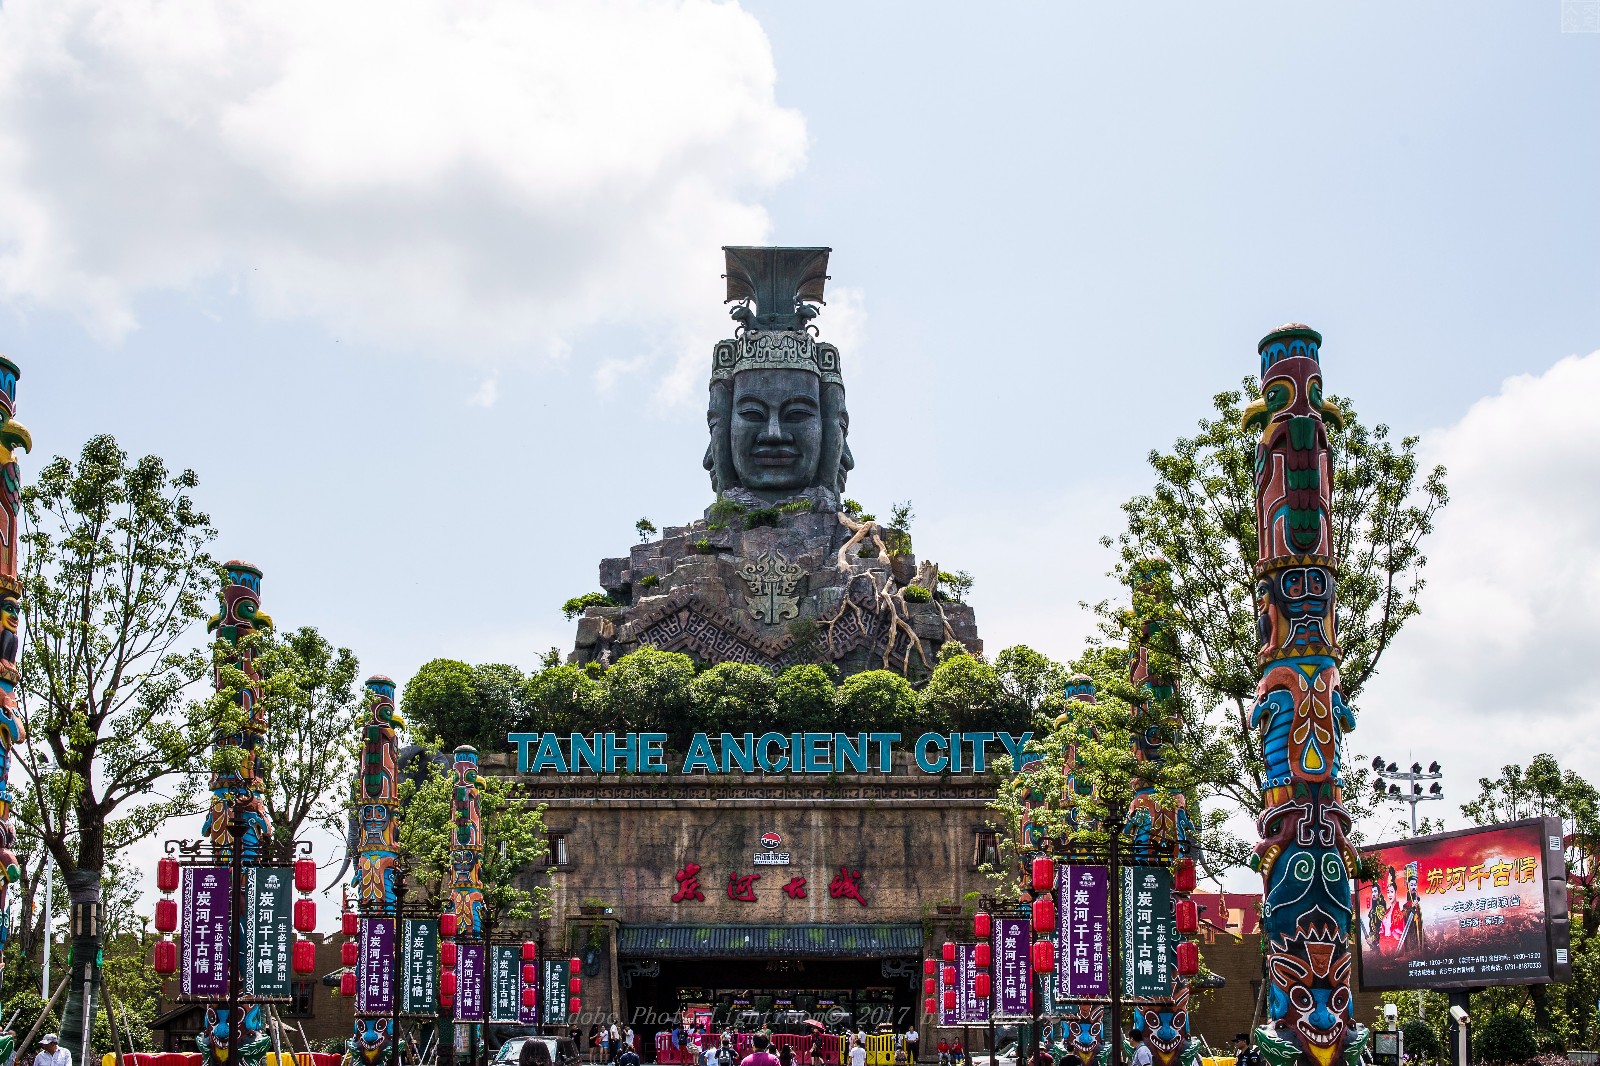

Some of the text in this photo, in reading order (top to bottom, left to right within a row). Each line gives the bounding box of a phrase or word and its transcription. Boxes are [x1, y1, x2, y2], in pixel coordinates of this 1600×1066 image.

[507, 731, 1034, 774] TANHE ANCIENT CITY
[1424, 855, 1538, 895] 炭河千古情
[194, 890, 212, 974] 炭河千古情
[214, 916, 224, 981] 一生必看的演出
[257, 891, 275, 974] 炭河千古情
[277, 916, 287, 982] 一生必看的演出
[1073, 890, 1090, 975] 炭河千古情
[1093, 914, 1103, 982] 一生必看的演出
[1136, 891, 1154, 976] 炭河千古情
[1156, 916, 1167, 984] 一生必看的演出
[368, 936, 381, 997] 炭河千古情
[411, 936, 424, 997] 炭河千古情
[463, 959, 474, 1007] 炭河千古情
[498, 960, 509, 1008] 炭河千古情
[550, 972, 560, 1014] 炭河千古情
[966, 959, 978, 1008] 炭河千古情
[1004, 937, 1017, 999] 炭河千古情
